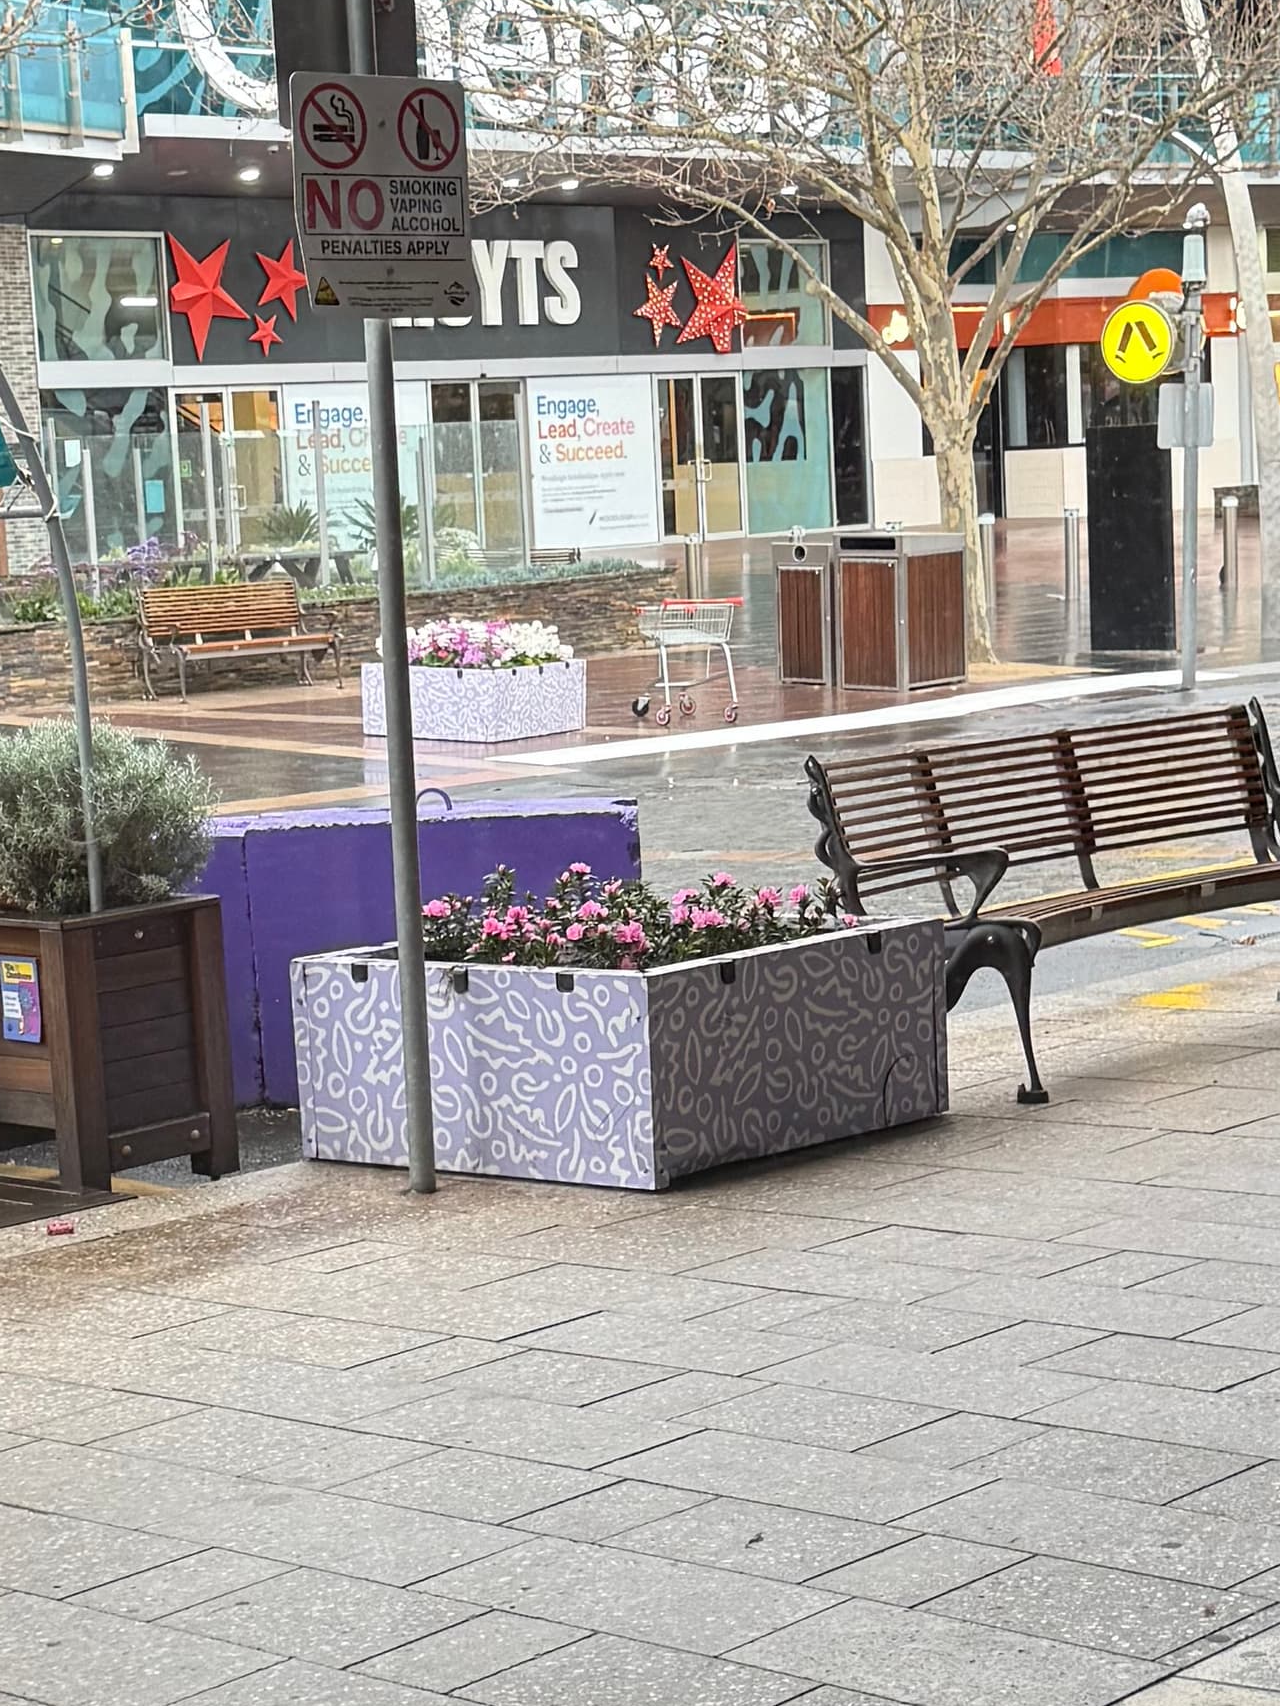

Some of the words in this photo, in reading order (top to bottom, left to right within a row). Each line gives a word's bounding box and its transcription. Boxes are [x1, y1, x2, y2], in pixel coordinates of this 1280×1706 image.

[389, 179, 457, 195] SMOKING
[305, 178, 385, 231] NO
[390, 197, 443, 214] VAPING
[391, 216, 461, 233] ALCOHOL
[321, 239, 402, 255] PENALTIES
[407, 239, 450, 255] APPLY
[391, 239, 581, 327] YTS
[537, 395, 600, 419] Engage,
[348, 427, 407, 447] Cre
[538, 419, 581, 441] Lead,
[583, 417, 636, 437] Create
[539, 443, 551, 464] &
[556, 440, 628, 462] Succeed.
[298, 453, 312, 477] &
